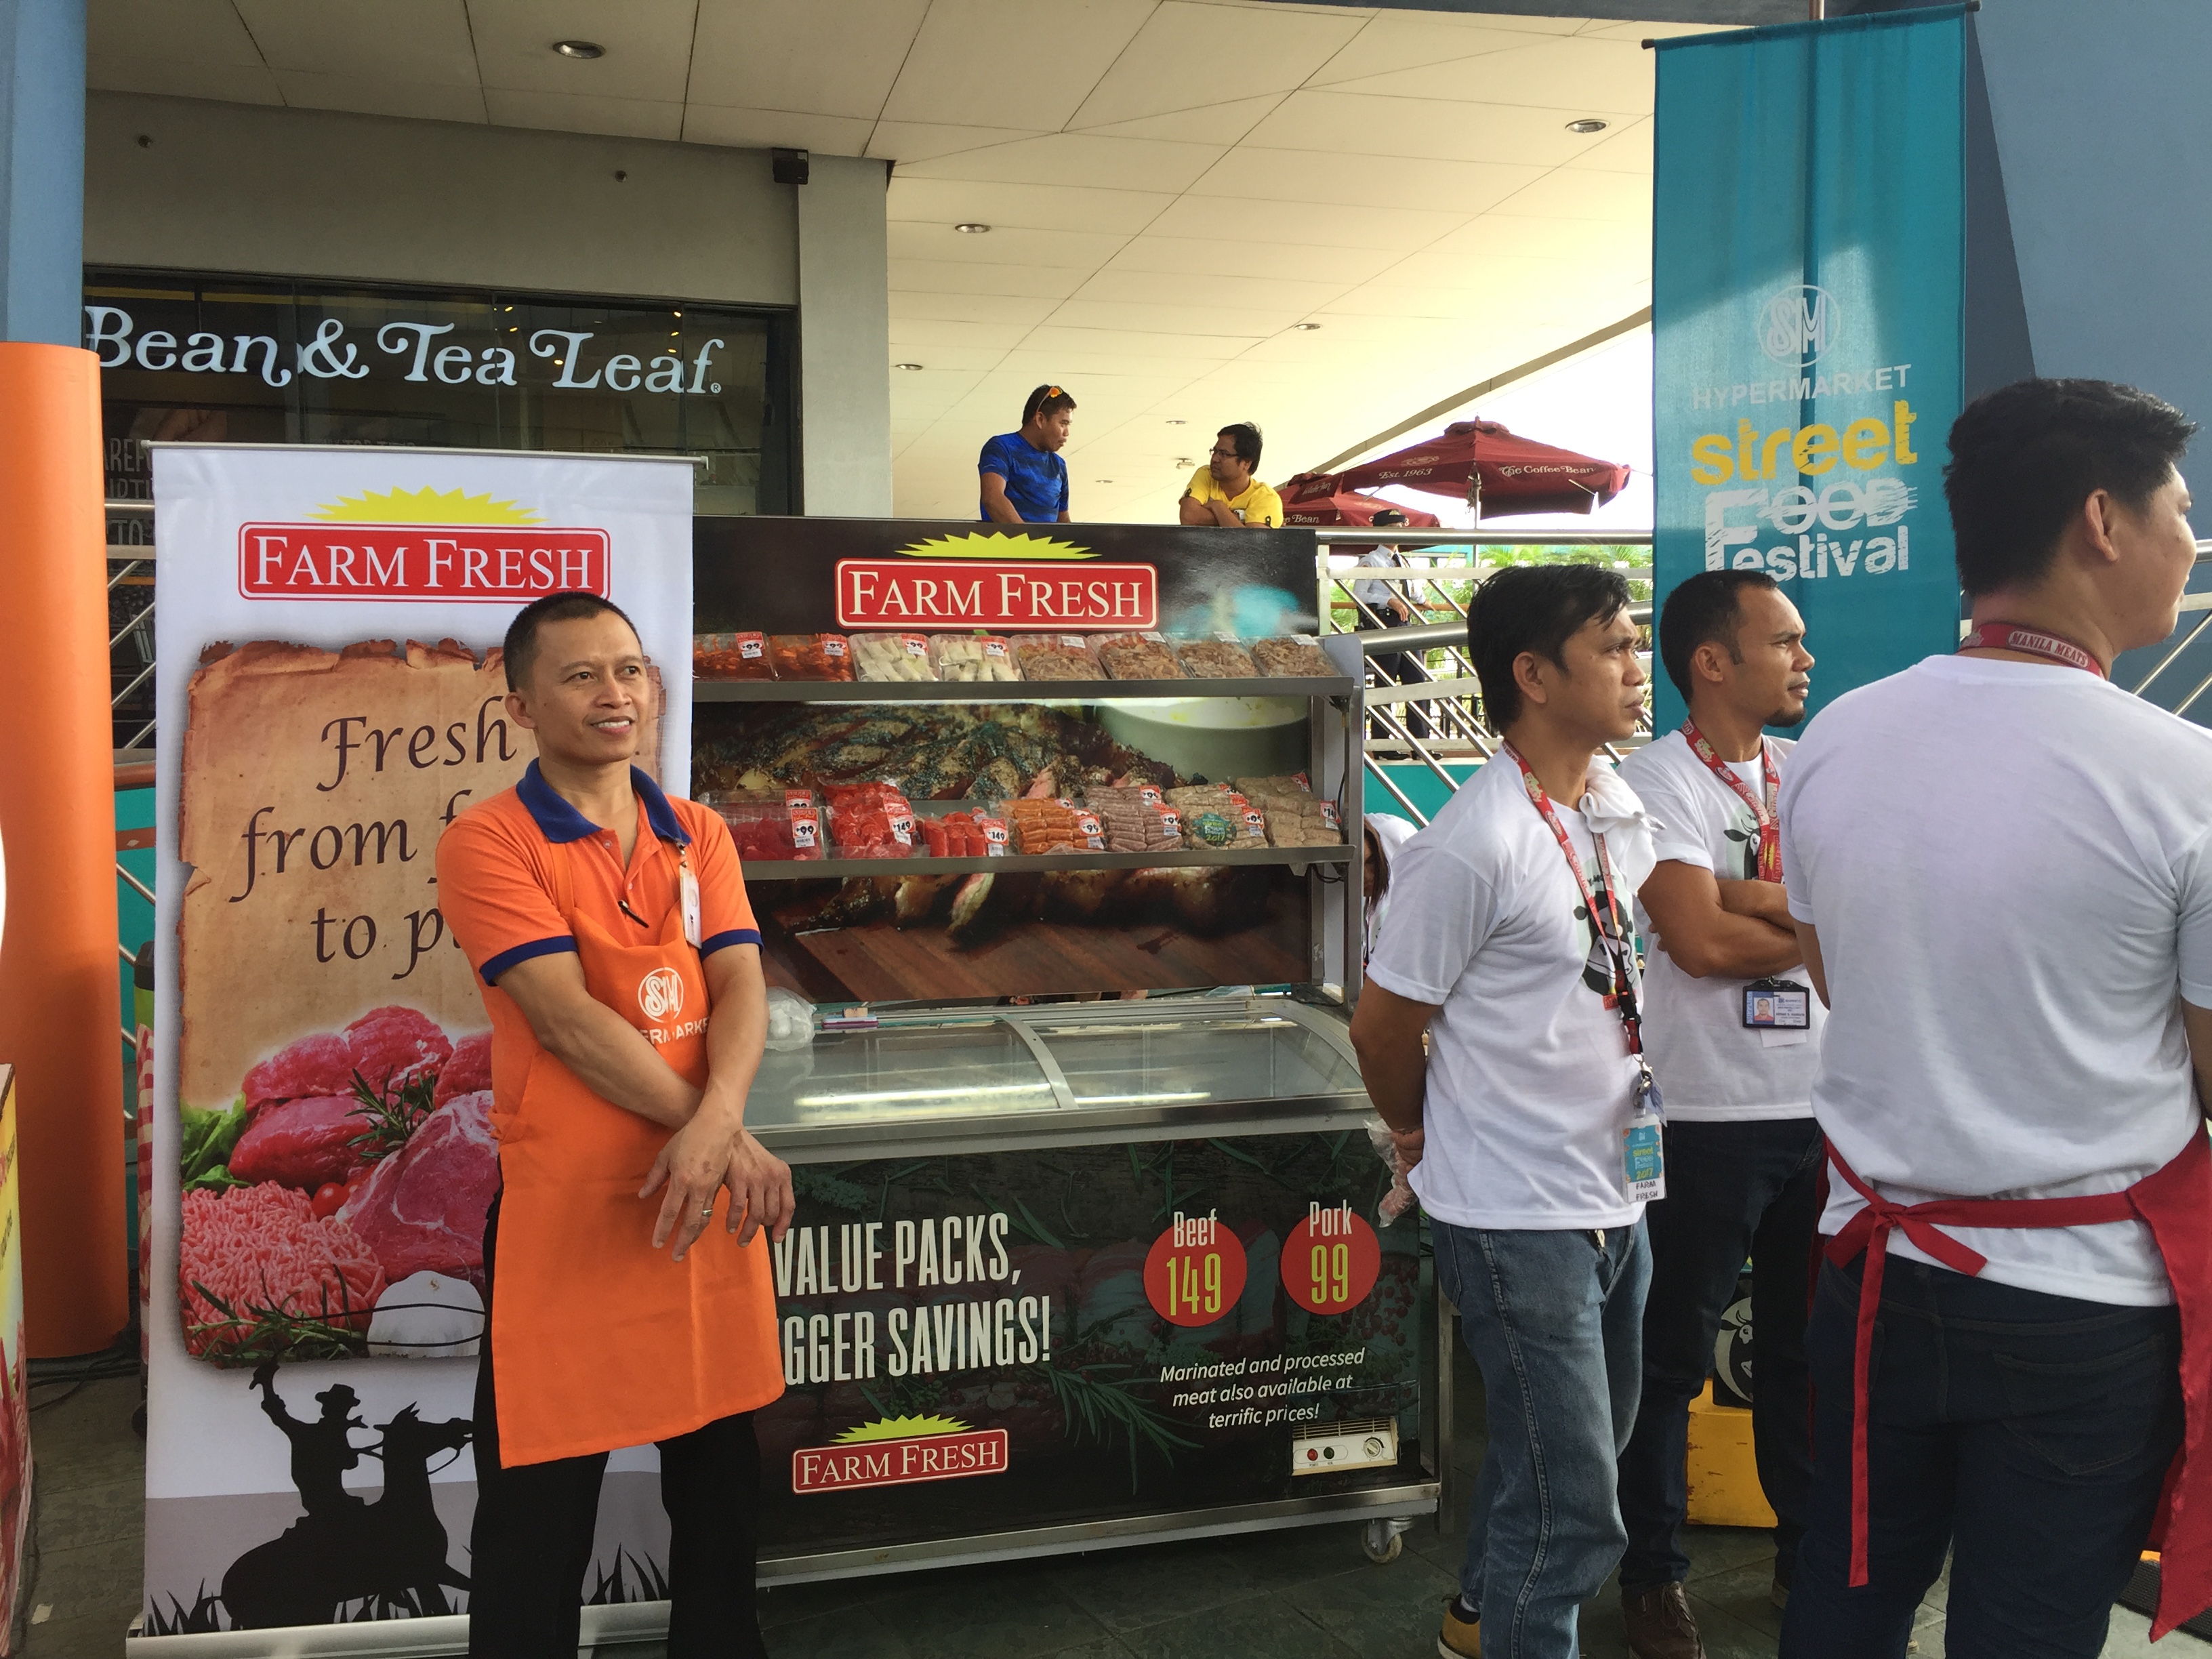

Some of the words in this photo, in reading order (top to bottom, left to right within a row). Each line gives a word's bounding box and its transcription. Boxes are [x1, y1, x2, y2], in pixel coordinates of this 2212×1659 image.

[85, 305, 291, 387] Bean
[304, 319, 369, 379] &
[377, 322, 517, 386] Tea
[1693, 364, 1911, 409] HYPERMARKET
[1690, 400, 1917, 485] street
[1378, 471, 1400, 479] Est.
[1403, 468, 1432, 477] 1963
[1498, 466, 1521, 477] The
[1561, 466, 1596, 474] Bean
[1292, 514, 1319, 523] Bean
[253, 536, 409, 588] FARM
[423, 539, 592, 590] FRESH
[848, 571, 984, 617] FARM
[996, 573, 1143, 618] FRESH
[2011, 632, 2052, 651] MANILA
[2054, 644, 2088, 665] MEATS
[316, 697, 516, 791] Fresh
[229, 807, 418, 903] from
[311, 907, 377, 962] to
[645, 974, 683, 1013] SM
[1636, 1182, 1656, 1190] FARM
[1637, 1168, 1654, 1180] 2017
[1636, 1191, 1658, 1201] FRESH
[1174, 1209, 1217, 1248] Beef
[1309, 1200, 1352, 1237] Pork
[774, 1223, 883, 1296] VALUE
[896, 1212, 1021, 1288] PACKS,
[1311, 1243, 1349, 1304] 99
[1167, 1253, 1221, 1316] 149
[777, 1311, 875, 1385] GGER
[888, 1295, 1050, 1376] SAVINGS!
[1160, 1358, 1246, 1382] Marinated
[1250, 1355, 1281, 1372] and
[1285, 1348, 1366, 1374] processed
[1172, 1389, 1216, 1406] meat
[1221, 1384, 1253, 1403] also
[1258, 1375, 1330, 1397] available
[1335, 1375, 1352, 1389] at
[1208, 1408, 1261, 1429] terrific
[1265, 1403, 1320, 1427] prices!
[800, 1454, 890, 1486] FARM
[900, 1440, 1000, 1475] FRESH
